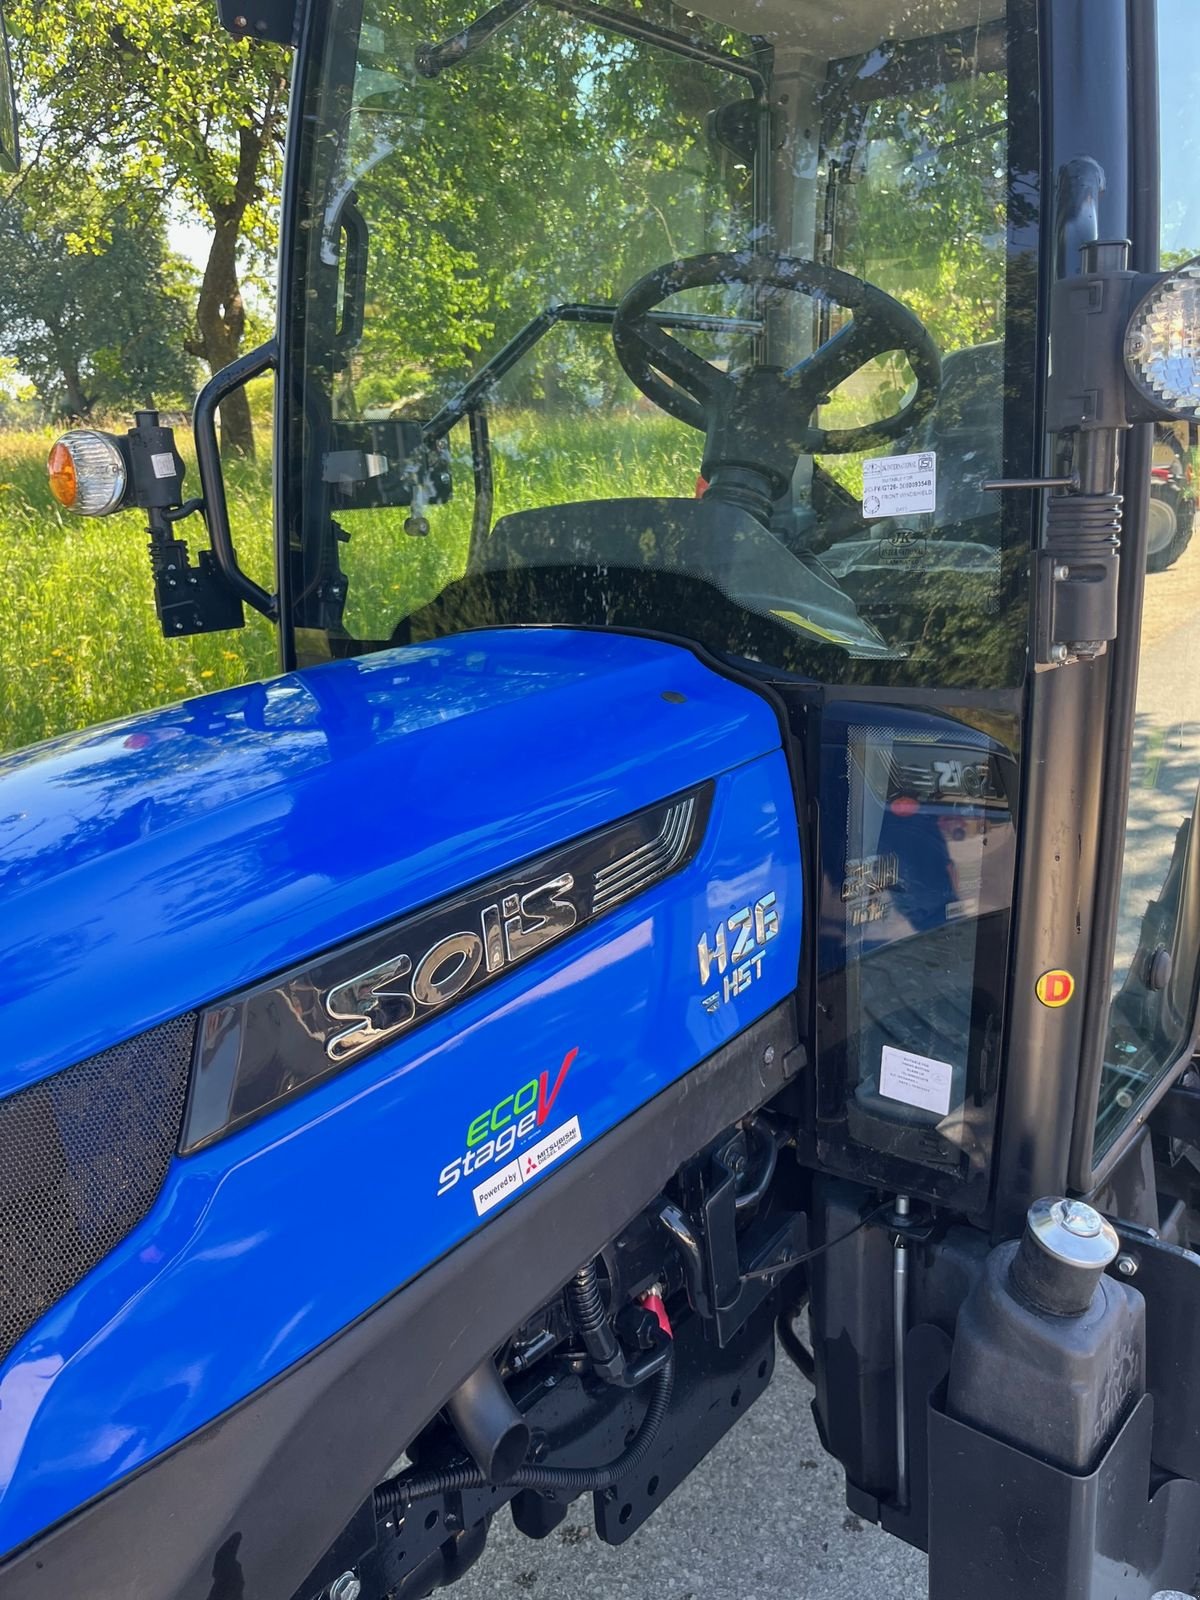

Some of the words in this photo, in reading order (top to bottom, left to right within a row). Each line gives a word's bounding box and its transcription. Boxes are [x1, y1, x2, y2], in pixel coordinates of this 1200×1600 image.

[723, 950, 766, 1004] HST
[1045, 974, 1071, 1001] D
[466, 1079, 539, 1147] ECO
[536, 1046, 579, 1126] V
[437, 1110, 537, 1197] Stage
[537, 1127, 577, 1160] MITSUBISHI
[538, 1149, 558, 1165] DIESEL
[479, 1176, 508, 1204] Powered
[508, 1172, 518, 1183] by
